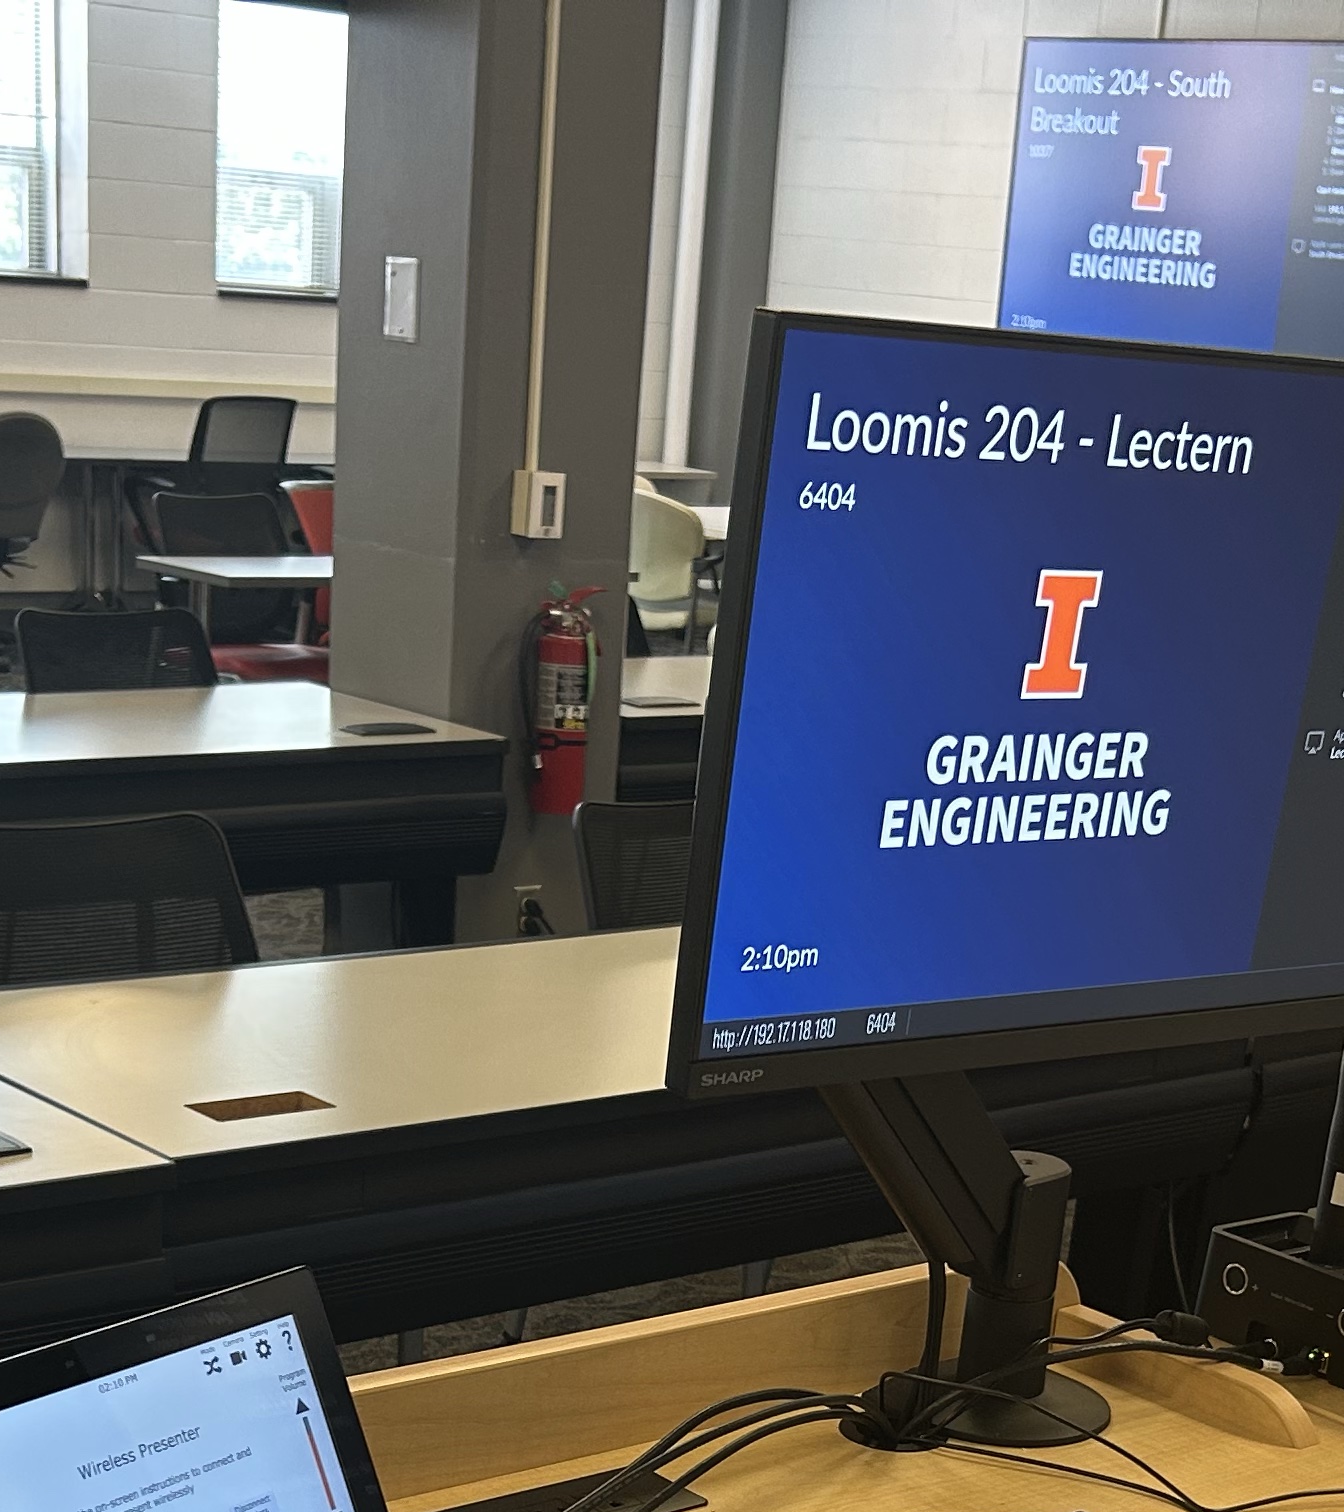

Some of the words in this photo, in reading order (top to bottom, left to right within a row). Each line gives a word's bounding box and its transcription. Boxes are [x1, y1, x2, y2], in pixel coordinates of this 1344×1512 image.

[1034, 67, 1104, 95] Loomis
[1107, 68, 1150, 96] 204
[1167, 68, 1232, 99] South
[1030, 106, 1121, 136] Breakout
[1088, 223, 1202, 256] GRAINGER
[1068, 251, 1216, 289] ENGINEERING
[805, 391, 969, 459] Loomis
[978, 405, 1066, 464] 204
[1106, 413, 1254, 475] Lectern
[798, 481, 856, 512] 6404
[926, 731, 1149, 785] GRAINGER
[879, 789, 1172, 849] ENGINEERING
[740, 944, 819, 973] 2:10pm
[866, 1011, 897, 1035] 6404
[700, 1069, 764, 1087] SHARP
[98, 1379, 124, 1394] 02:10
[125, 1373, 139, 1385] PM
[279, 1368, 306, 1382] Program
[282, 1380, 307, 1392] Volume
[77, 1450, 137, 1480] Wireless
[138, 1427, 201, 1458] Presenter
[139, 1471, 191, 1497] instructions
[191, 1467, 201, 1478] to
[202, 1454, 235, 1473] connect
[236, 1446, 253, 1460] and
[154, 1484, 195, 1507] wirelessly
